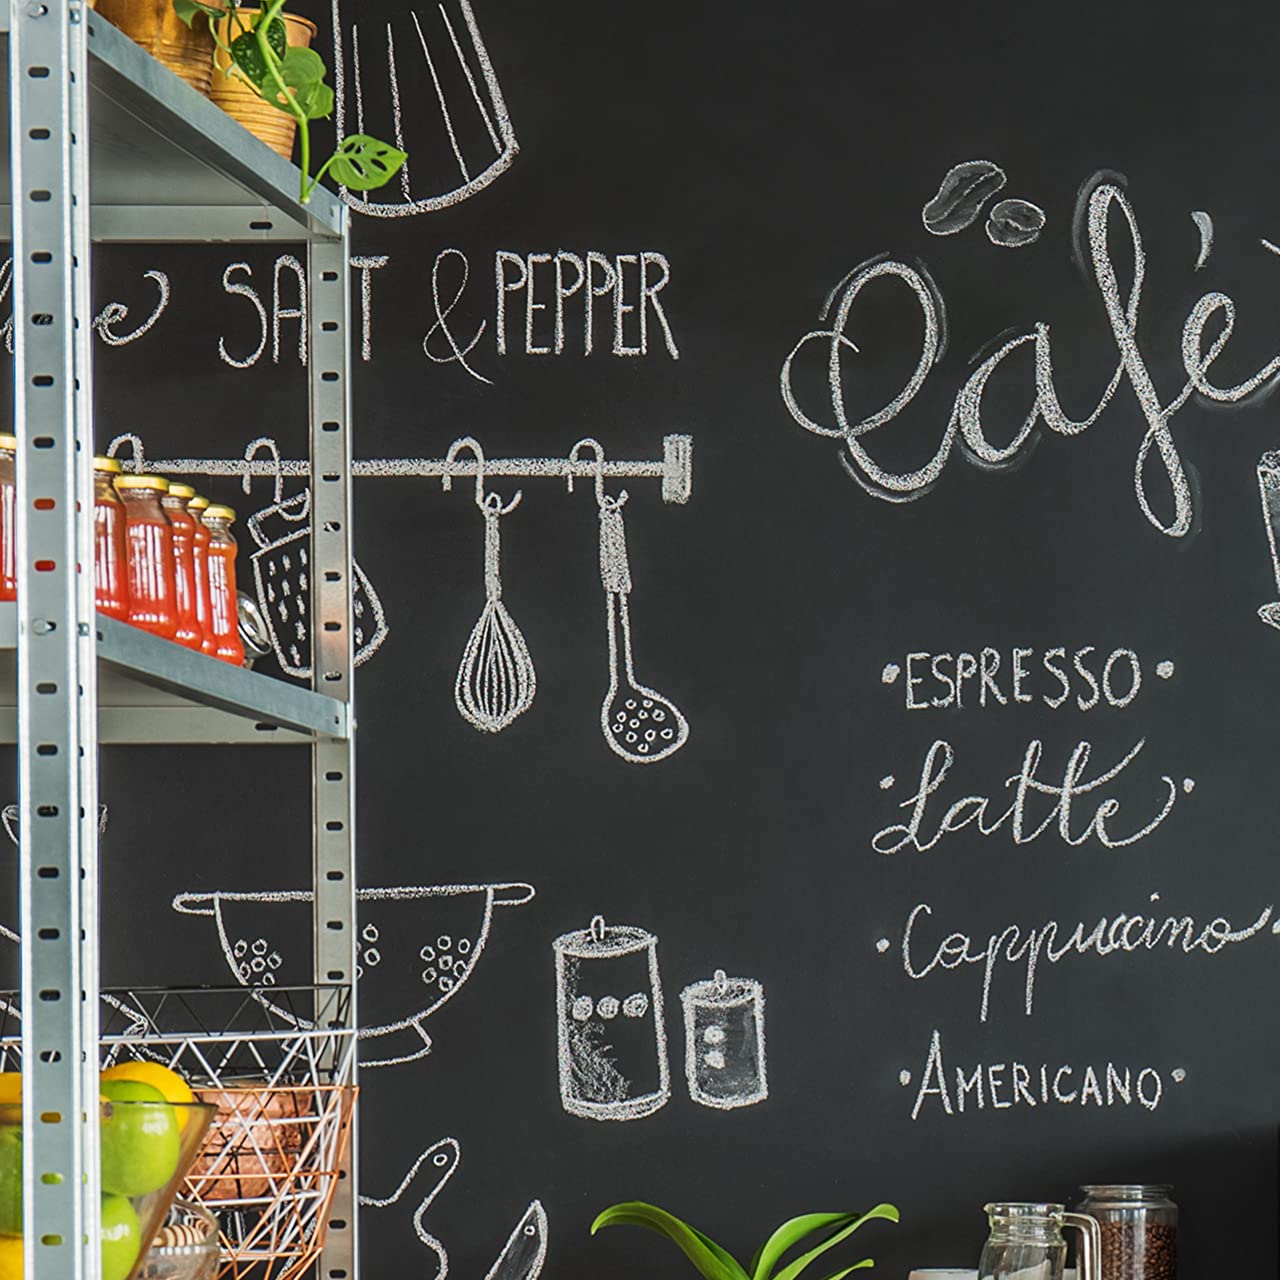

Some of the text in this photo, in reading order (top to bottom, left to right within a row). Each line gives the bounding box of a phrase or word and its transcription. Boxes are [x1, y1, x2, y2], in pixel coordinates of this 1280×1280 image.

[218, 254, 390, 368] SAT
[424, 247, 494, 385] &
[496, 248, 680, 360] PEPPER
[905, 646, 1143, 711] ESPRESSO
[871, 736, 1177, 854] Latte
[902, 891, 1274, 1023] Cappuccino
